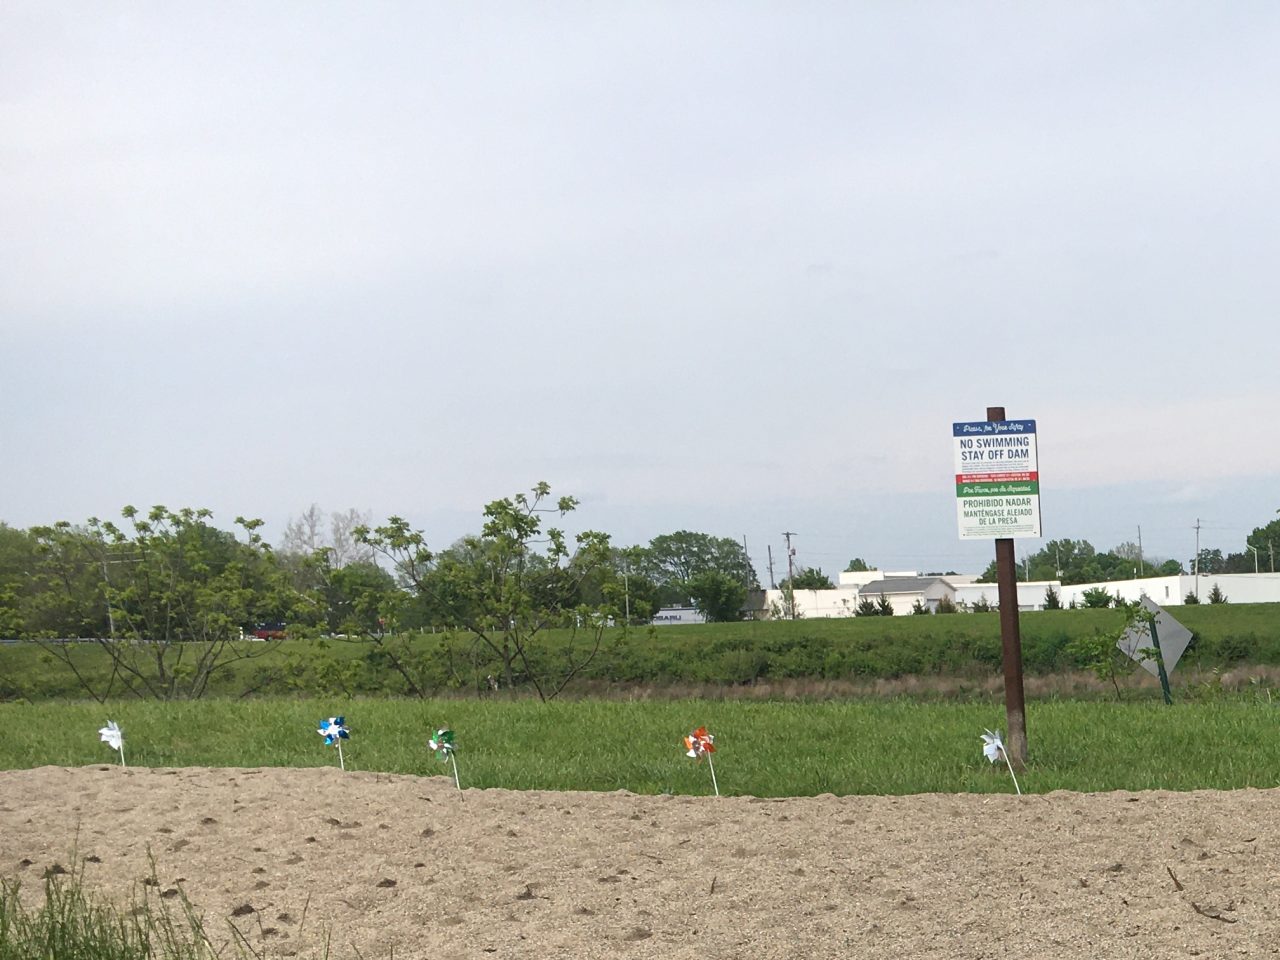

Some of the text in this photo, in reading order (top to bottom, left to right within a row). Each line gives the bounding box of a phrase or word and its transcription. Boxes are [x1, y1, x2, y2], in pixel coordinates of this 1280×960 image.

[960, 436, 1030, 449] NO SWIMMING
[961, 448, 1029, 461] STAY OFF DAM
[963, 497, 1032, 508] PROHIBIDO NADAR
[1006, 508, 1033, 517] ALEJADO
[988, 517, 996, 525] LA
[997, 517, 1018, 525] PRESA
